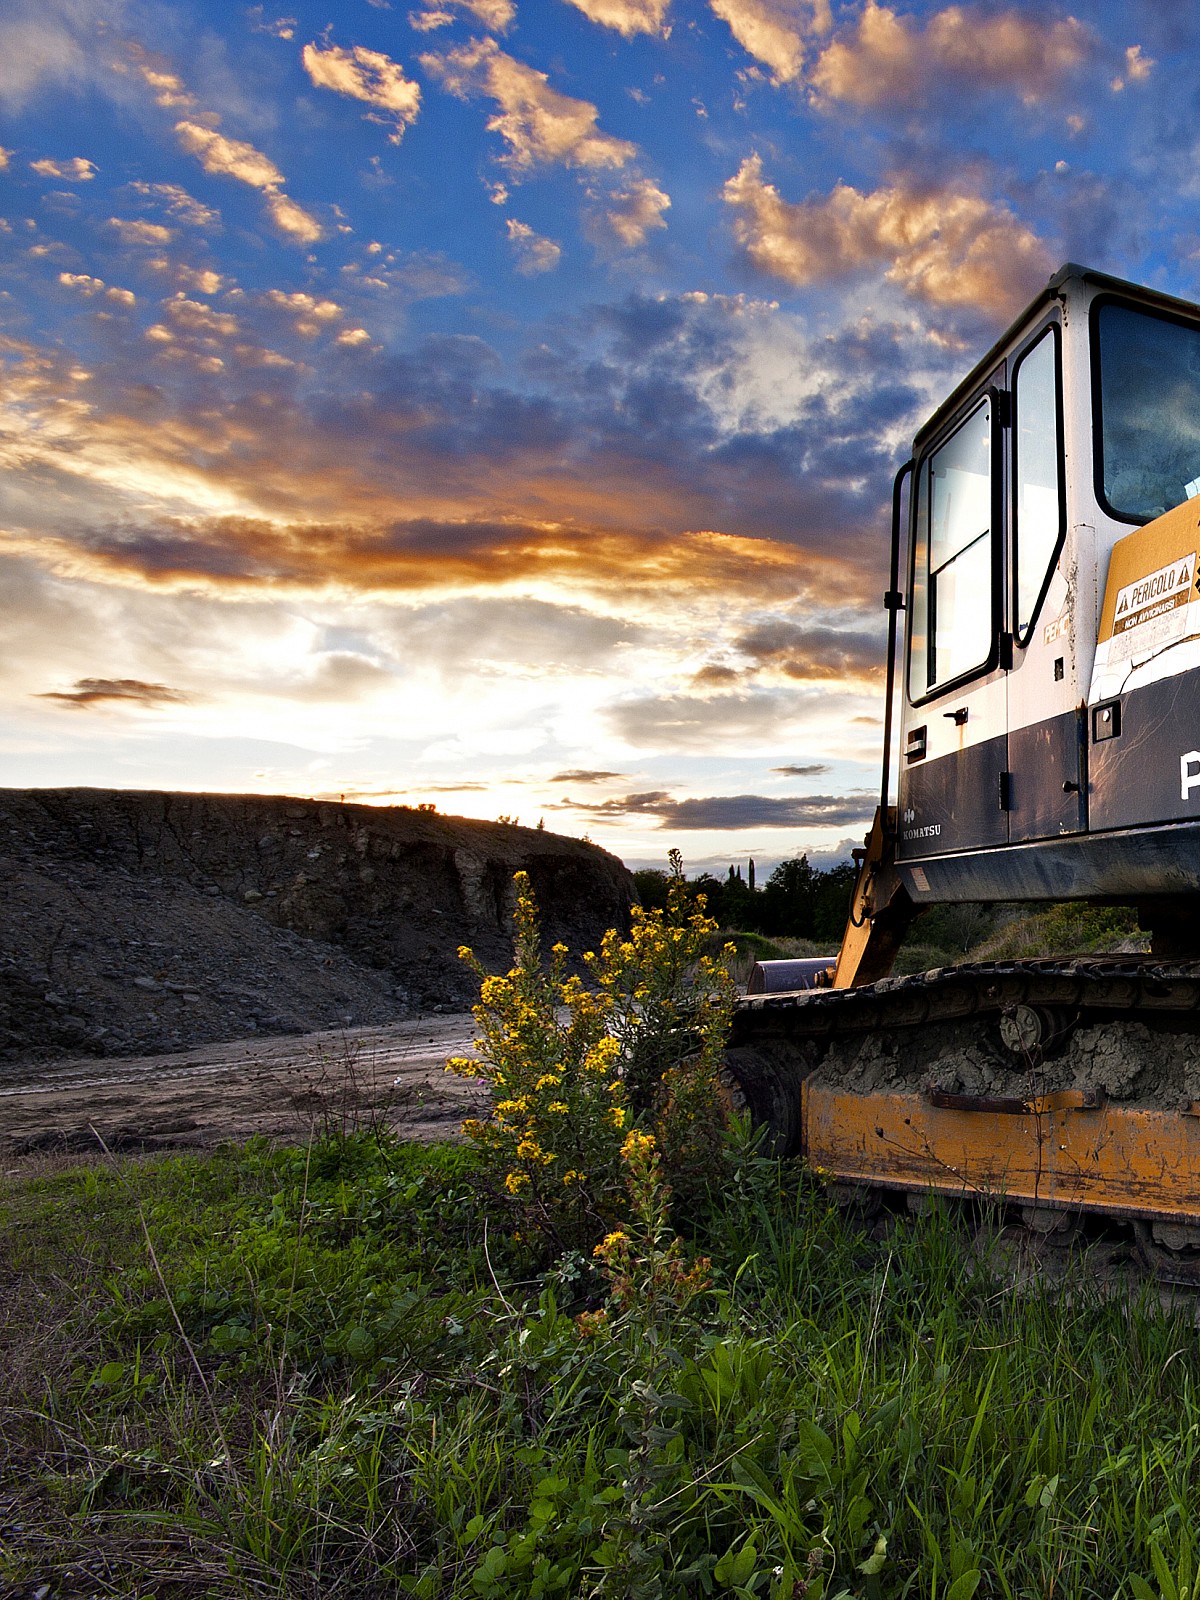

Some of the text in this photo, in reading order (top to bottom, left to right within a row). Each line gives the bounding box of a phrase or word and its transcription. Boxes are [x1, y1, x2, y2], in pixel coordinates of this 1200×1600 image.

[1131, 569, 1175, 608] PERICOLO
[1124, 599, 1176, 630] NON AVVICINARSI
[903, 824, 941, 840] KOMATSU
